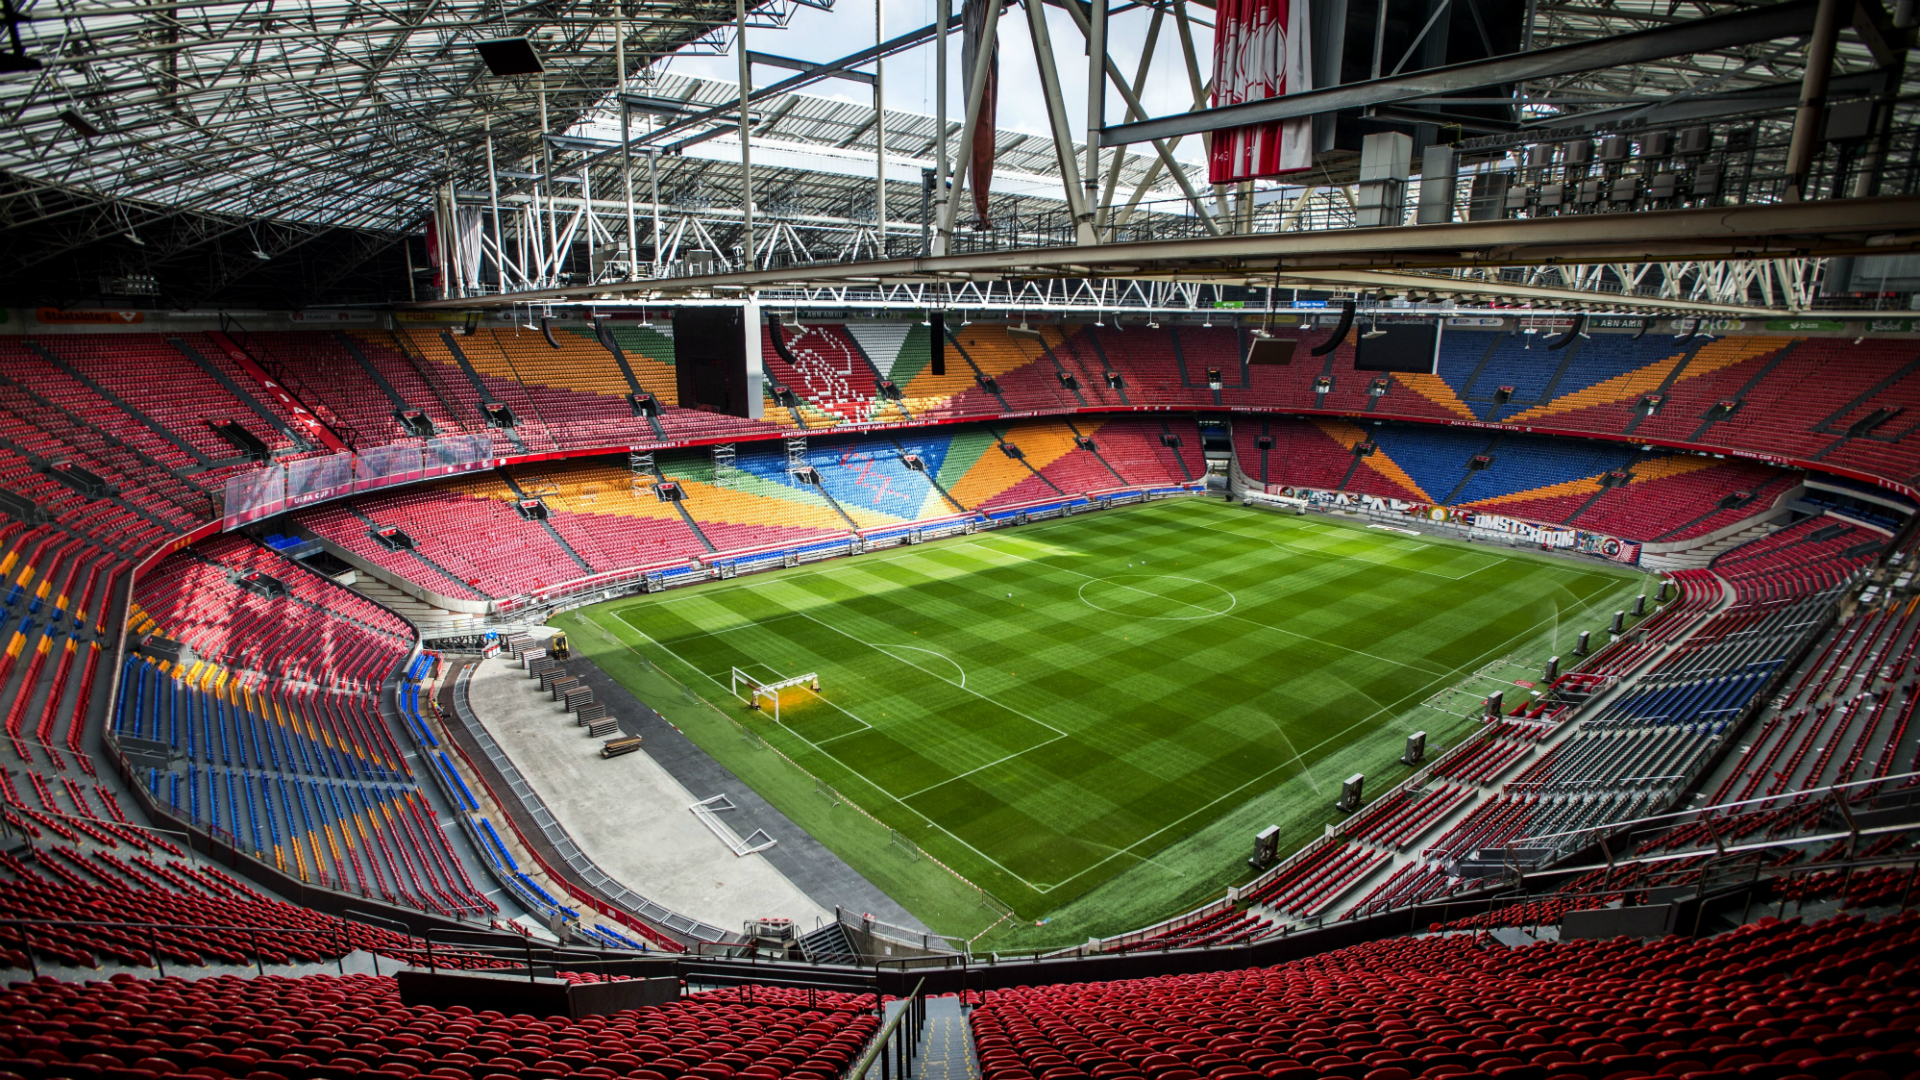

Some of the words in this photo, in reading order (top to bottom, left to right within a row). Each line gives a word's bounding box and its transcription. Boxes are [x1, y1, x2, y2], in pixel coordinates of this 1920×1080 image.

[45, 311, 111, 322] Staatsloterij
[405, 312, 436, 320] FEBO
[1800, 321, 1818, 329] bam
[264, 380, 320, 428] AJAX
[629, 442, 676, 451] WERELDBEKER
[1732, 450, 1757, 459] EUROPA
[1758, 453, 1772, 461] CUP
[294, 494, 313, 504] UEFA
